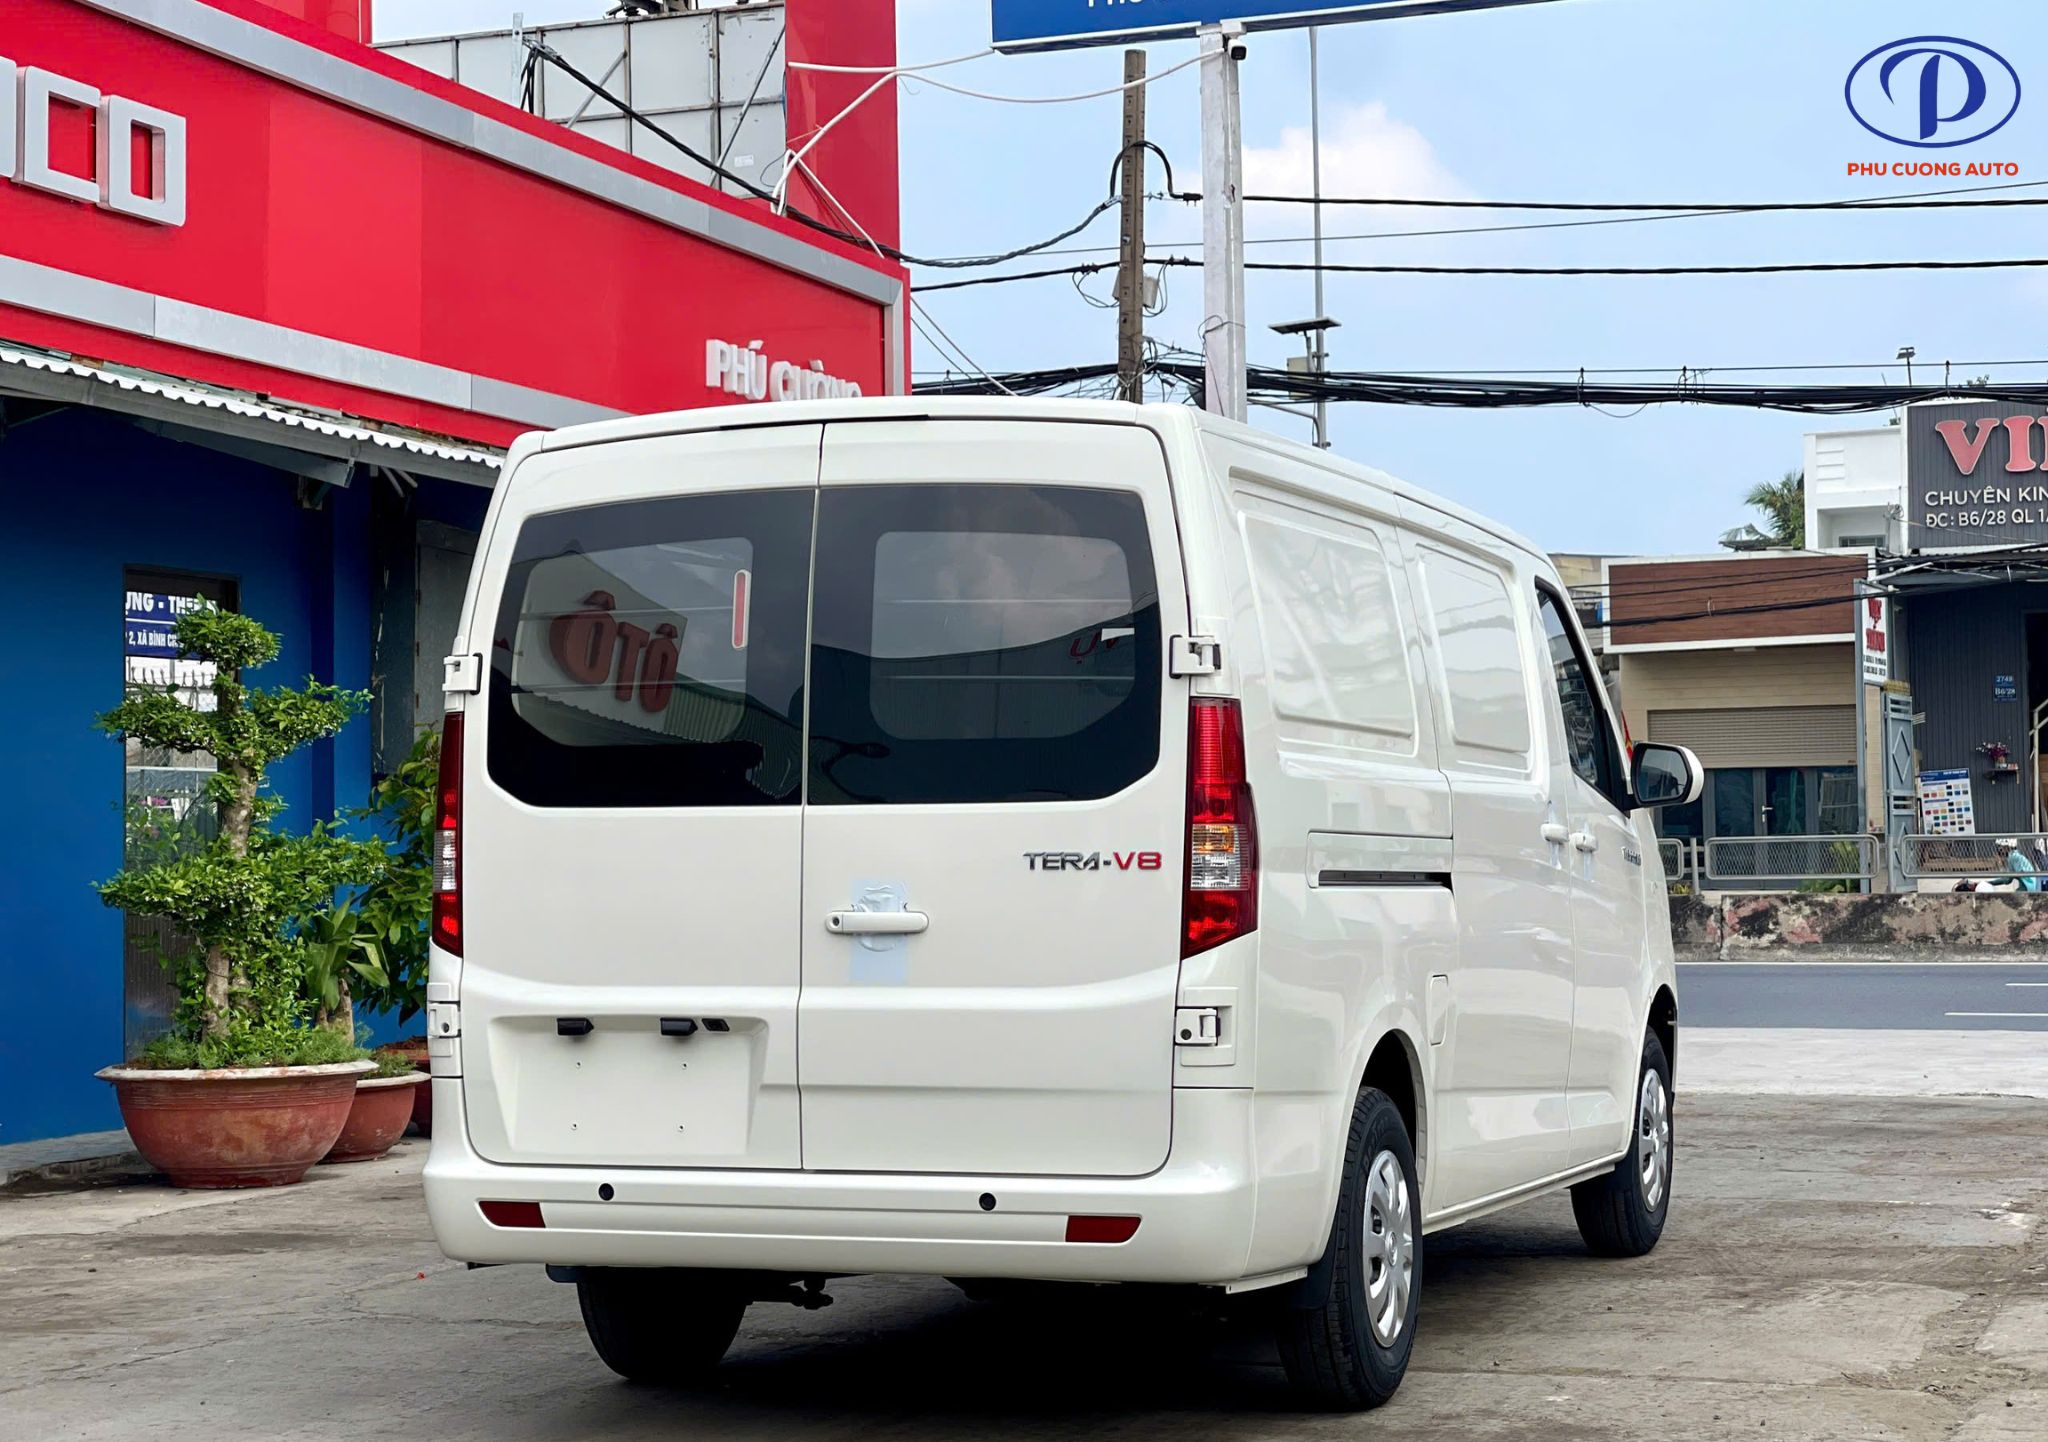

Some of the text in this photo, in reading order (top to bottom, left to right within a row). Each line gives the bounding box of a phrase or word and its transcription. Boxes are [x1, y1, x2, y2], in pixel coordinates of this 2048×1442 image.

[0, 56, 187, 227] CO
[706, 339, 767, 400] PHÚ
[1925, 485, 2010, 506] CHUYÊN
[1958, 508, 2006, 527] B6/28
[2011, 508, 2034, 524] QL
[137, 628, 148, 646] XÃ
[148, 630, 166, 647] BÌNH
[1022, 851, 1162, 871] TERA-V8
